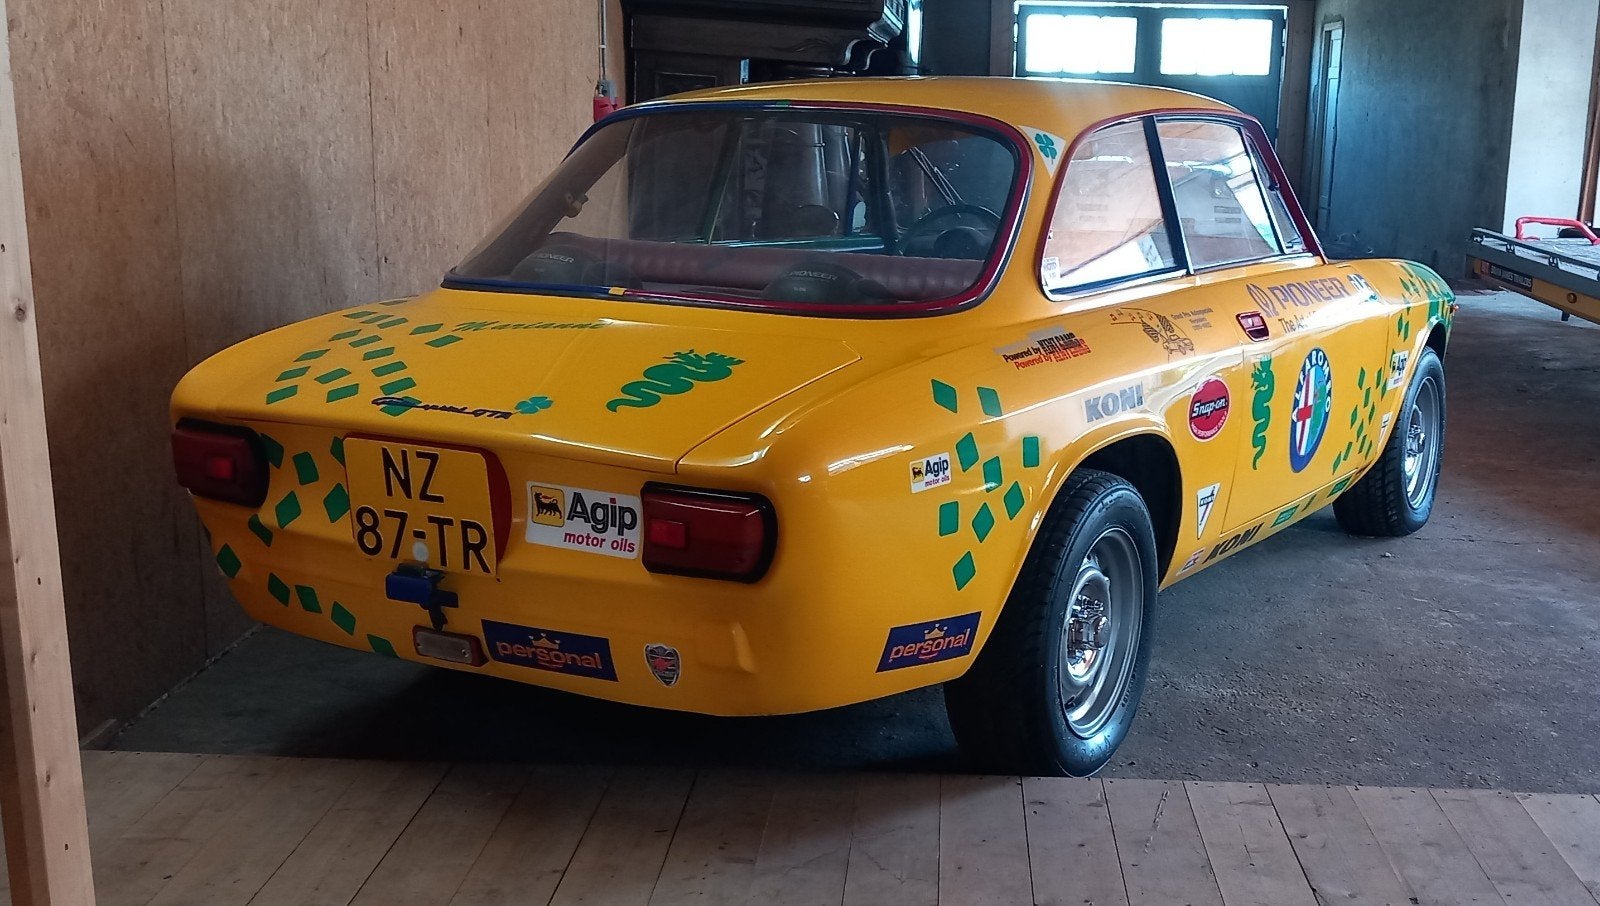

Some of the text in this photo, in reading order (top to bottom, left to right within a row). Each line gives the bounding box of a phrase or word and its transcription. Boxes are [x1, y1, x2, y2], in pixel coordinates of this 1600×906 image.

[1267, 277, 1351, 310] PIONEER
[1002, 347, 1034, 363] Powered
[1031, 346, 1042, 355] by
[1014, 355, 1044, 370] Powered
[1084, 380, 1144, 423] KONI
[381, 447, 445, 504] NZ
[924, 456, 949, 477] Agip
[566, 491, 638, 537] Agip
[355, 504, 492, 575] 87-TR
[563, 530, 636, 553] motor oils
[495, 640, 603, 670] personal
[888, 629, 971, 662] personal
